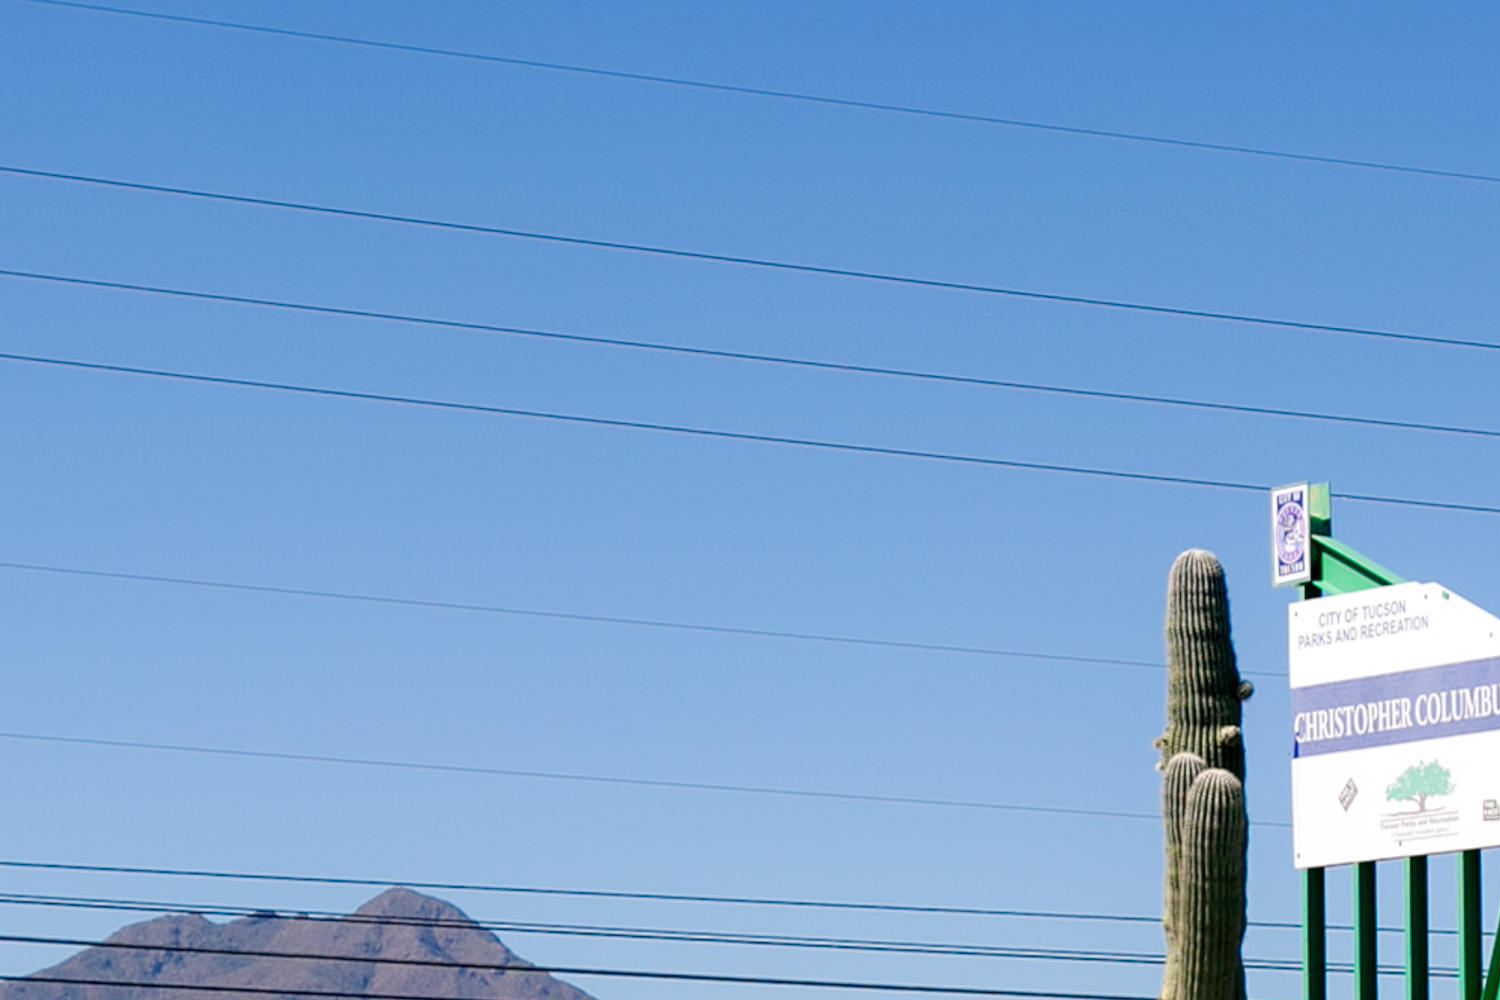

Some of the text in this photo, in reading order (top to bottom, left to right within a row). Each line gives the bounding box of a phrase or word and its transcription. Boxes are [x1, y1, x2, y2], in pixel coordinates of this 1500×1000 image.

[1318, 599, 1407, 628] CITY OF TUCSON
[1298, 614, 1429, 649] PARKS AND RECREATION
[1294, 696, 1413, 743] CHRISTOPHER
